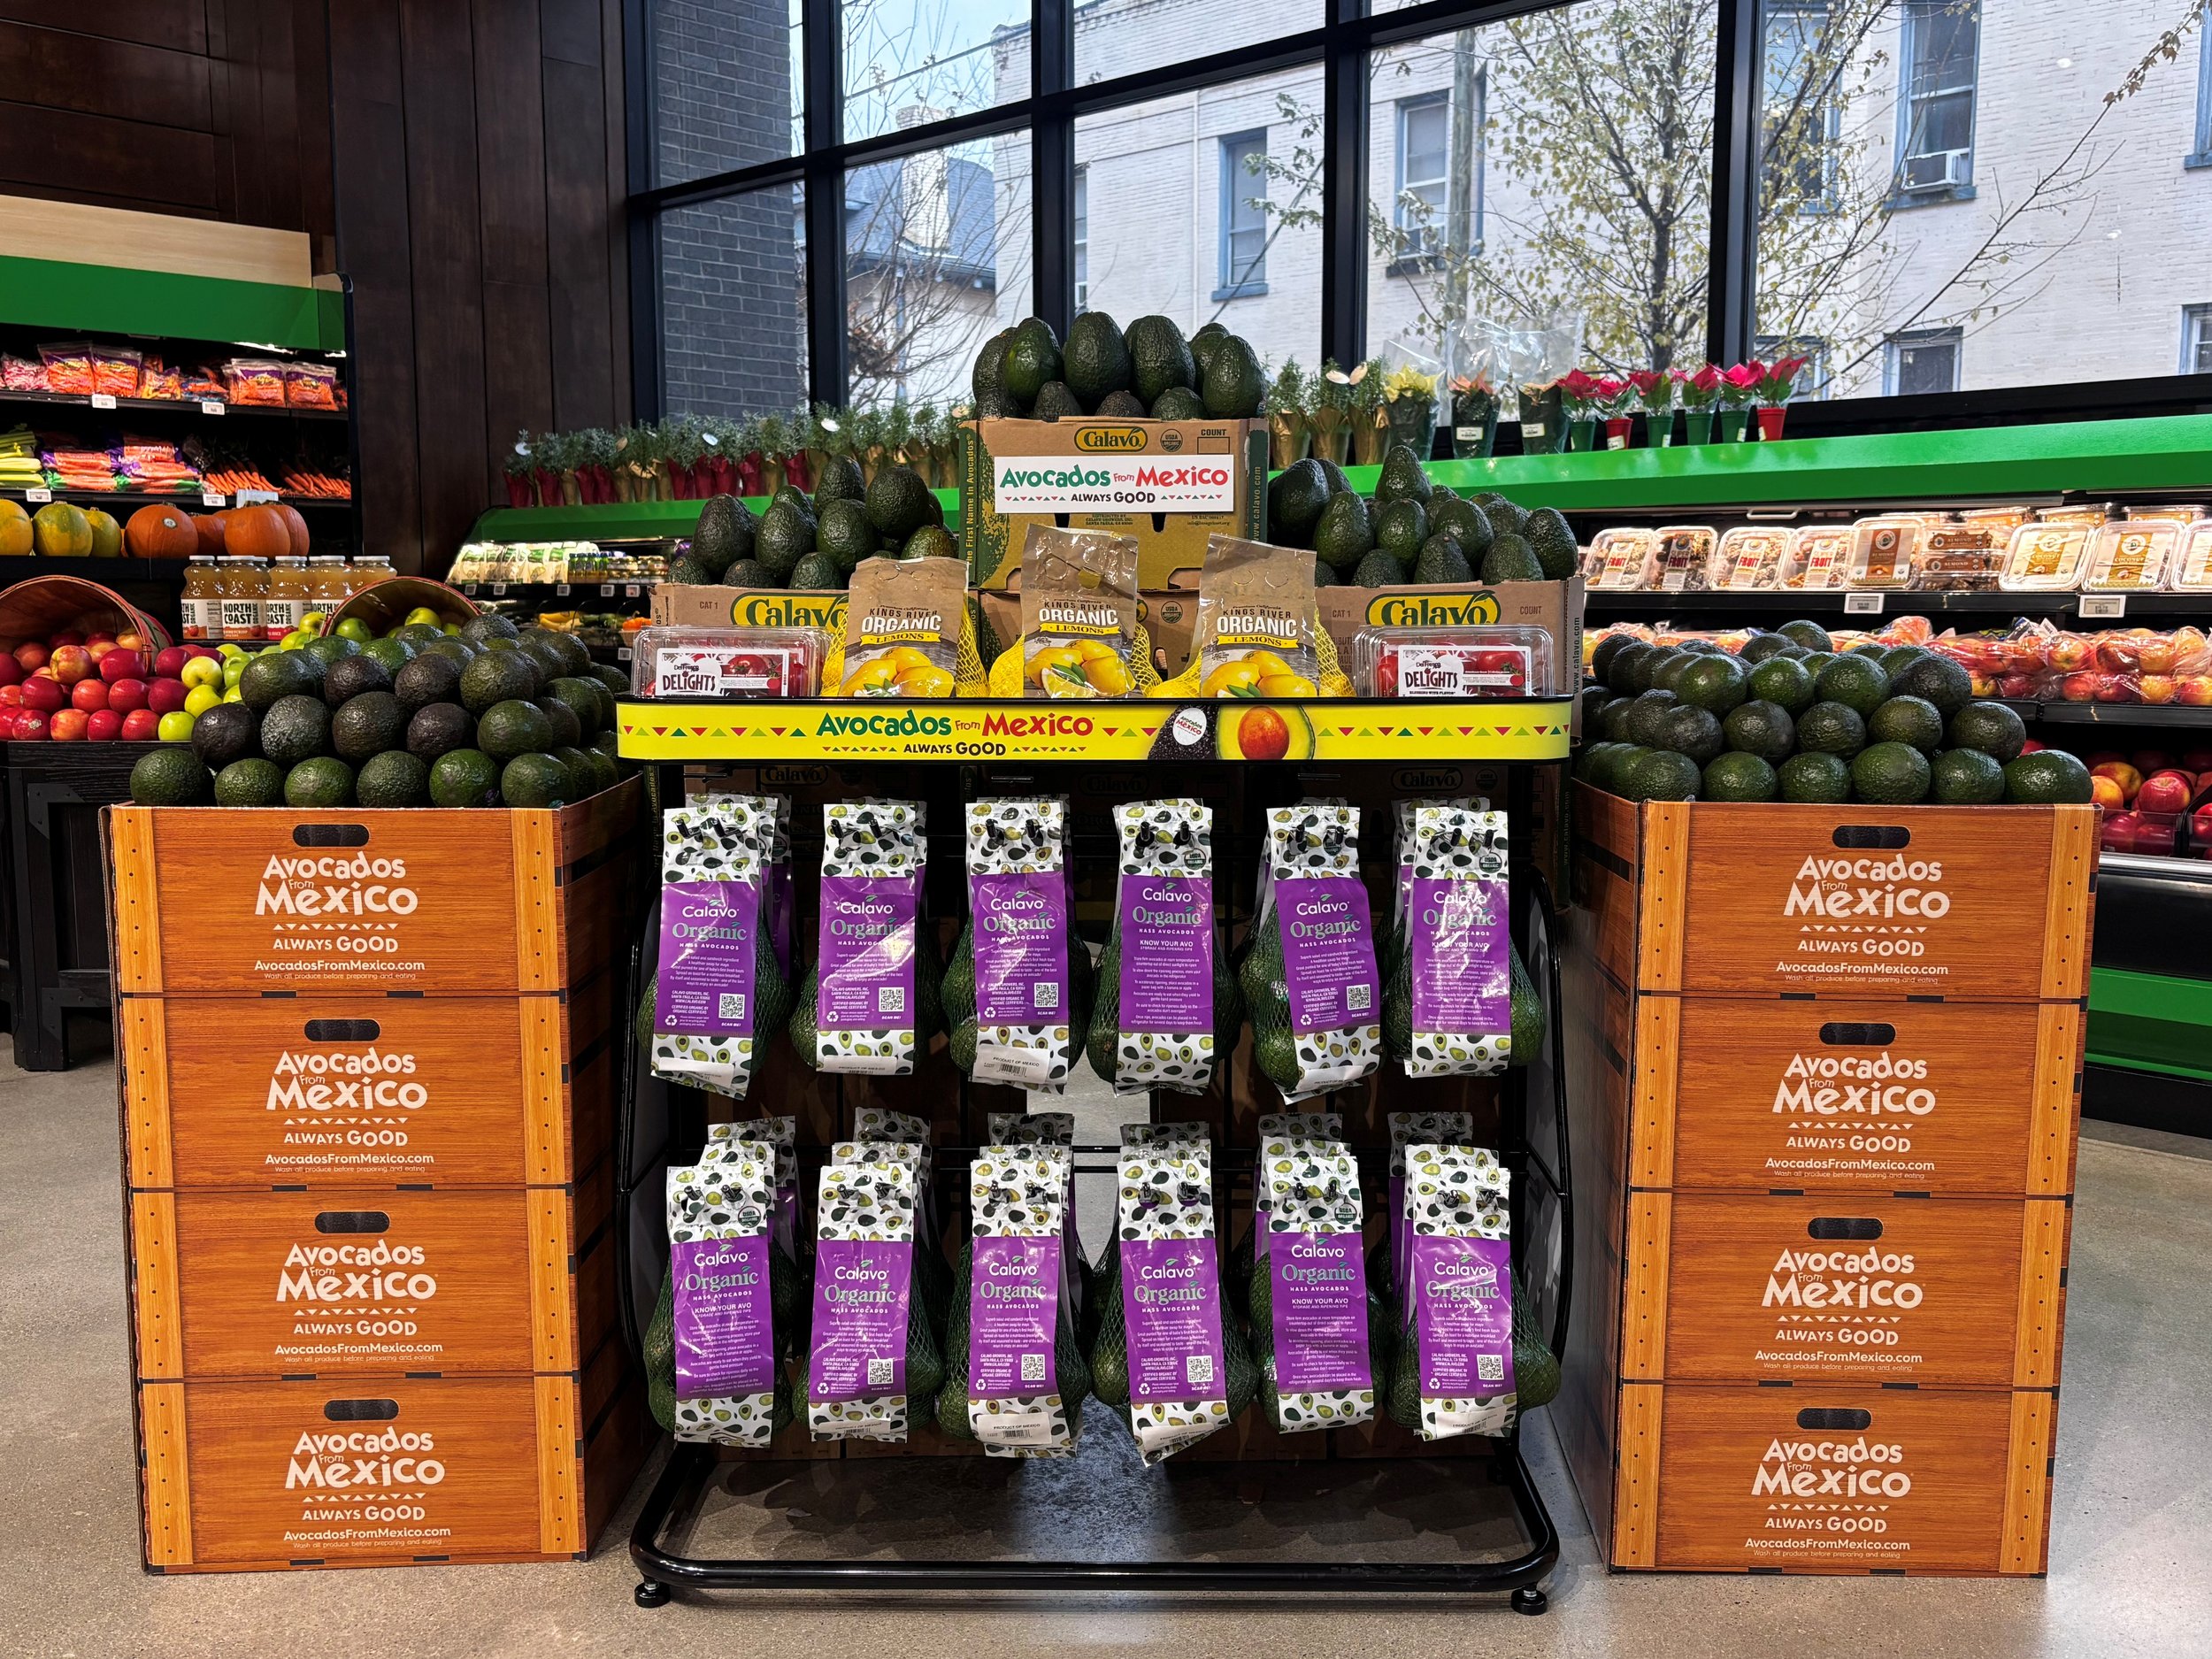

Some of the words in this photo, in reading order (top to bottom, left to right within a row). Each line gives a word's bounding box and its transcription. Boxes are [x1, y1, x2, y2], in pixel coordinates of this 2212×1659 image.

[1083, 429, 1141, 448] Calavo
[1000, 465, 1110, 488] Avocados
[1114, 473, 1134, 482] From
[1136, 466, 1228, 488] Mexico
[1071, 493, 1111, 503] ALWAYS
[1114, 491, 1156, 503] GOOD
[1607, 557, 1627, 567] FRUIT
[1668, 557, 1687, 567] FRUIT
[1738, 557, 1760, 567] FRUIT
[1811, 557, 1832, 567] FRUIT
[224, 603, 251, 613] NORTH
[870, 608, 901, 618] KINGS
[1260, 609, 1291, 618] RIVER
[1381, 597, 1489, 625] Calavo
[1520, 606, 1541, 615] COUNT
[224, 614, 251, 624] COAST
[861, 615, 941, 634] ORGANIC
[1039, 609, 1118, 626] ORGANIC
[1056, 625, 1104, 634] LEMONS
[1217, 616, 1297, 637] ORGANIC
[876, 634, 924, 643] LEMONS
[1234, 636, 1282, 647] LEMONS
[816, 709, 951, 736] Avocados
[955, 720, 980, 731] From
[982, 711, 1093, 737] Mexico
[903, 743, 952, 754] ALWAYS
[956, 741, 1006, 756] GOOD
[262, 851, 406, 879] Avocados
[1796, 854, 1942, 882] Avocados
[288, 879, 314, 890] From
[1822, 880, 1847, 891] From
[255, 880, 419, 916] Mexico
[1142, 887, 1192, 902] Calavo
[1433, 891, 1486, 904] Calavo
[1783, 881, 1950, 918] Mexico
[682, 906, 737, 918] Calavo
[841, 902, 894, 914] Calavo
[991, 899, 1044, 910] Calavo
[1296, 902, 1348, 916] Calavo
[1133, 906, 1202, 927] Organic
[1423, 910, 1497, 928] Organic
[672, 923, 747, 941] Organic
[983, 917, 1056, 933] Organic
[1290, 918, 1361, 940] Organic
[273, 939, 333, 951] ALWAYS
[336, 936, 399, 953] GOOD
[1797, 940, 1858, 953] ALWAYS
[1863, 939, 1924, 956] GOOD
[254, 960, 425, 972] AvocadosFromMexico.com
[1776, 962, 1948, 975] AvocadosFromMexico.com
[274, 1047, 416, 1075] Avocados
[1784, 1051, 1927, 1079] Avocados
[300, 1075, 326, 1085] From
[1809, 1079, 1834, 1088] From
[266, 1076, 428, 1110] Mexico
[1772, 1079, 1936, 1116] Mexico
[284, 1133, 342, 1145] ALWAYS
[347, 1130, 408, 1147] GOOD
[1786, 1137, 1845, 1149] ALWAYS
[1849, 1135, 1911, 1153] GOOD
[265, 1154, 434, 1164] AvocadosFromMexico.com
[1765, 1158, 1935, 1171] AvocadosFromMexico.com
[284, 1239, 426, 1267] Avocados
[1292, 1245, 1344, 1258] Calavo
[695, 1252, 749, 1267] Calavo
[1773, 1247, 1915, 1273] Avocados
[310, 1267, 335, 1277] From
[835, 1266, 887, 1280] Calavo
[989, 1263, 1037, 1276] Calavo
[1141, 1266, 1194, 1279] Calavo
[1282, 1264, 1356, 1284] Organic
[1434, 1262, 1489, 1277] Calavo
[276, 1268, 436, 1302] Mexico
[686, 1271, 759, 1292] Organic
[1798, 1272, 1823, 1283] From
[825, 1285, 896, 1306] Organic
[980, 1281, 1047, 1302] Organic
[1134, 1285, 1206, 1305] Organic
[1426, 1280, 1500, 1302] Organic
[1762, 1273, 1923, 1309] Mexico
[294, 1323, 352, 1334] ALWAYS
[357, 1320, 418, 1336] GOOD
[1775, 1330, 1833, 1341] ALWAYS
[1838, 1328, 1899, 1345] GOOD
[275, 1343, 442, 1355] AvocadosFromMexico.com
[1755, 1350, 1923, 1363] AvocadosFromMexico.com
[293, 1426, 434, 1455] Avocados
[1763, 1437, 1902, 1463] Avocados
[319, 1454, 343, 1463] From
[285, 1455, 445, 1489] Mexico
[1787, 1463, 1811, 1472] From
[1751, 1463, 1911, 1498] Mexico
[302, 1509, 361, 1521] ALWAYS
[365, 1505, 426, 1522] GOOD
[1765, 1517, 1823, 1530] ALWAYS
[1827, 1517, 1886, 1533] GOOD
[283, 1527, 451, 1541] AvocadosFromMexico.com
[1745, 1538, 1910, 1550] AvocadosFromMexico.com
